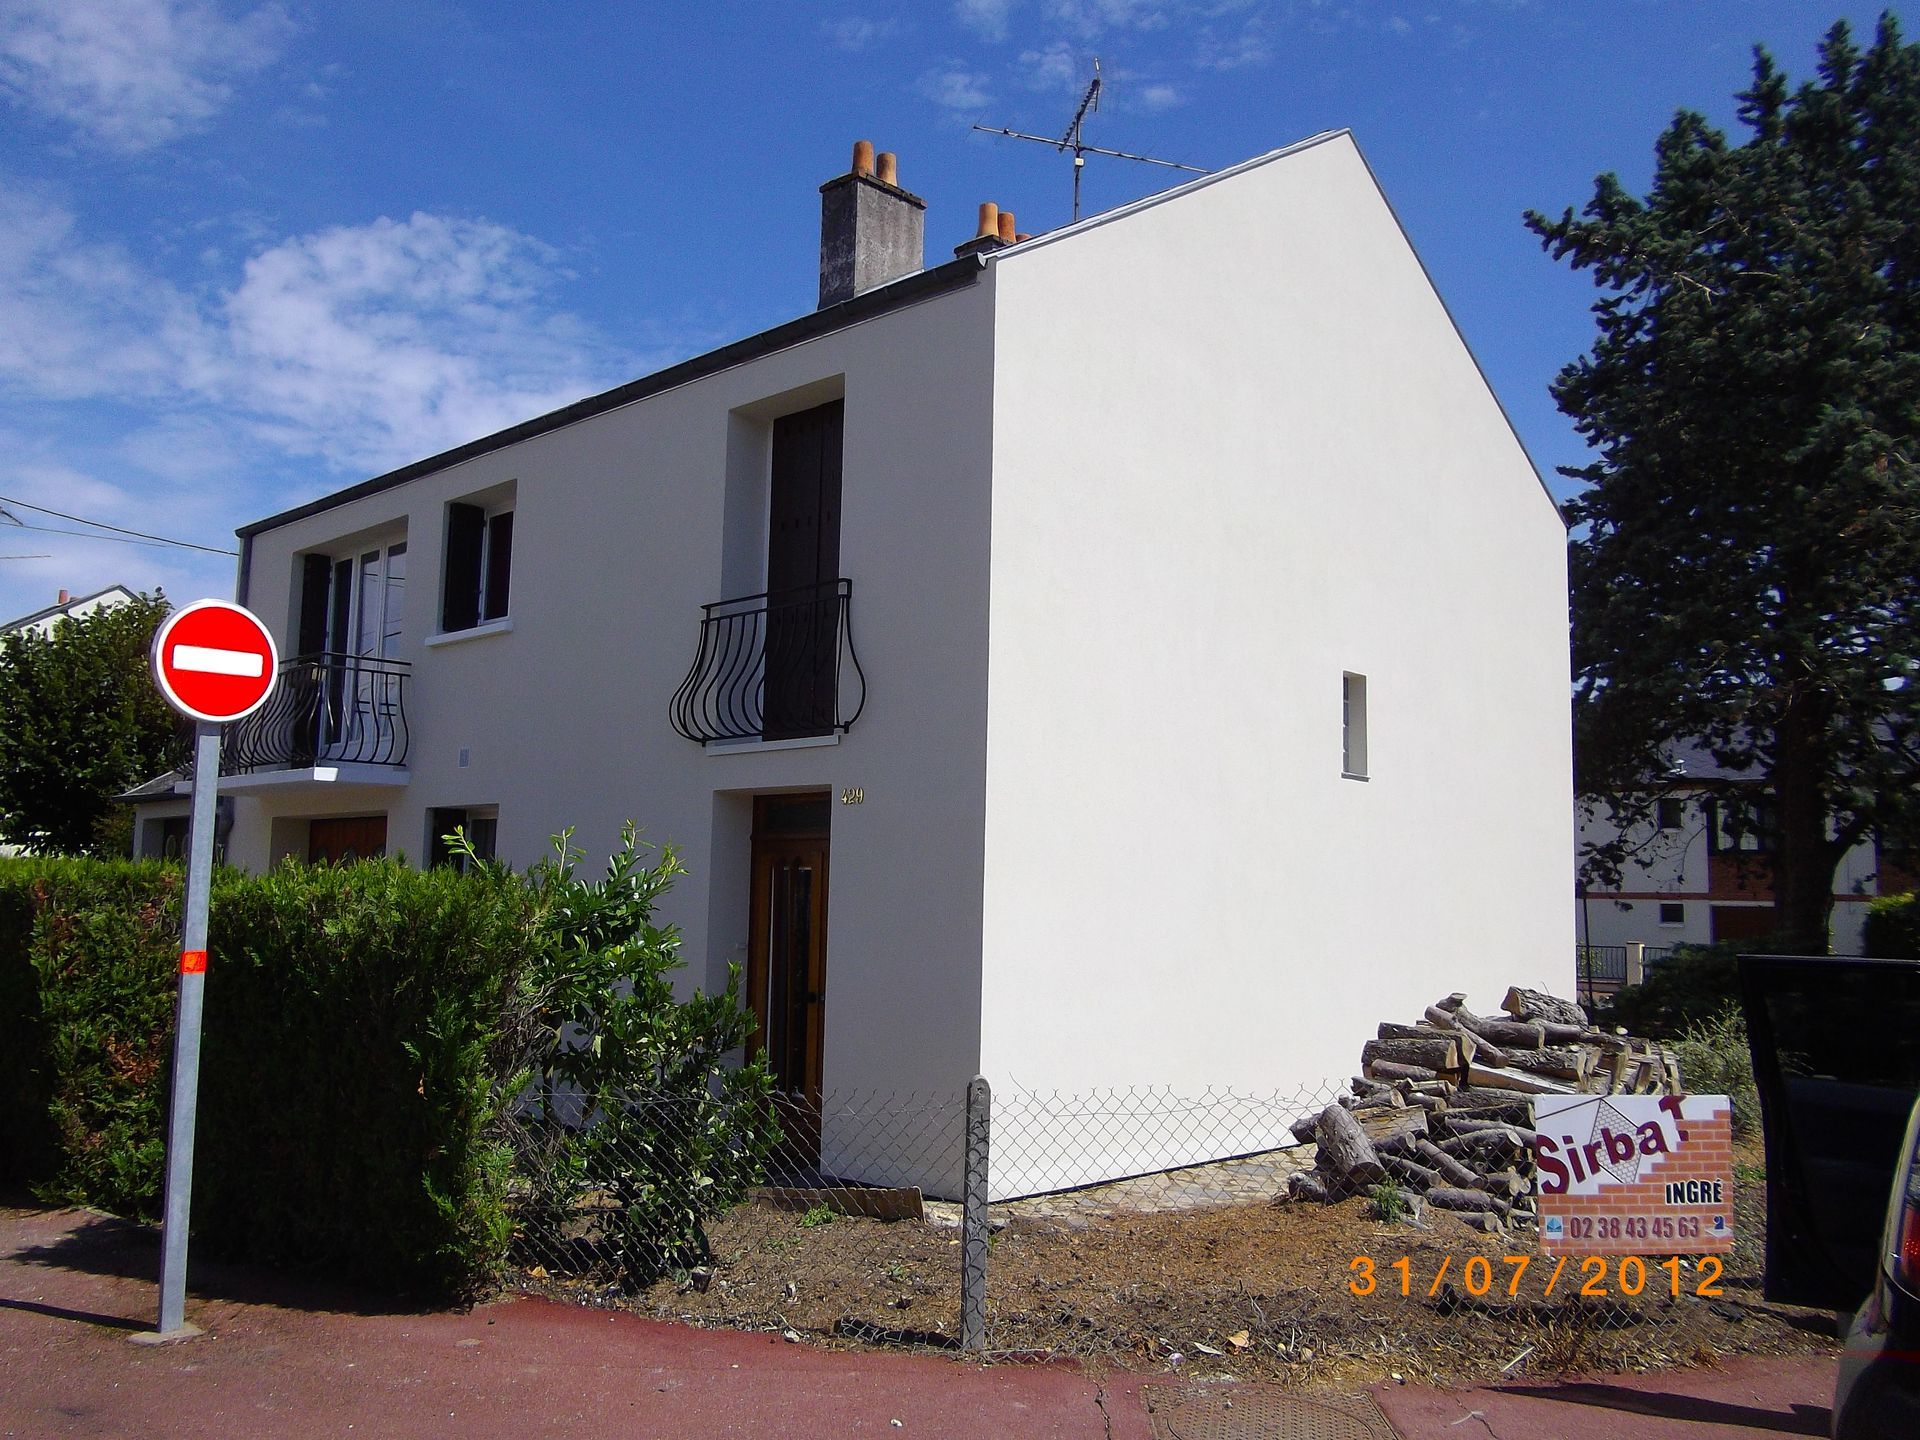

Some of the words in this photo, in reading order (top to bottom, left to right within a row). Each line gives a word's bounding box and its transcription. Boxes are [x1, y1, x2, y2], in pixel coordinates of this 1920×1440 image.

[1666, 1179, 1722, 1204] INGRÉ
[1570, 1217, 1593, 1239] 02
[1598, 1217, 1620, 1239] 38
[1625, 1217, 1647, 1239] 43
[1652, 1217, 1673, 1239] 45
[1678, 1216, 1699, 1238] 63
